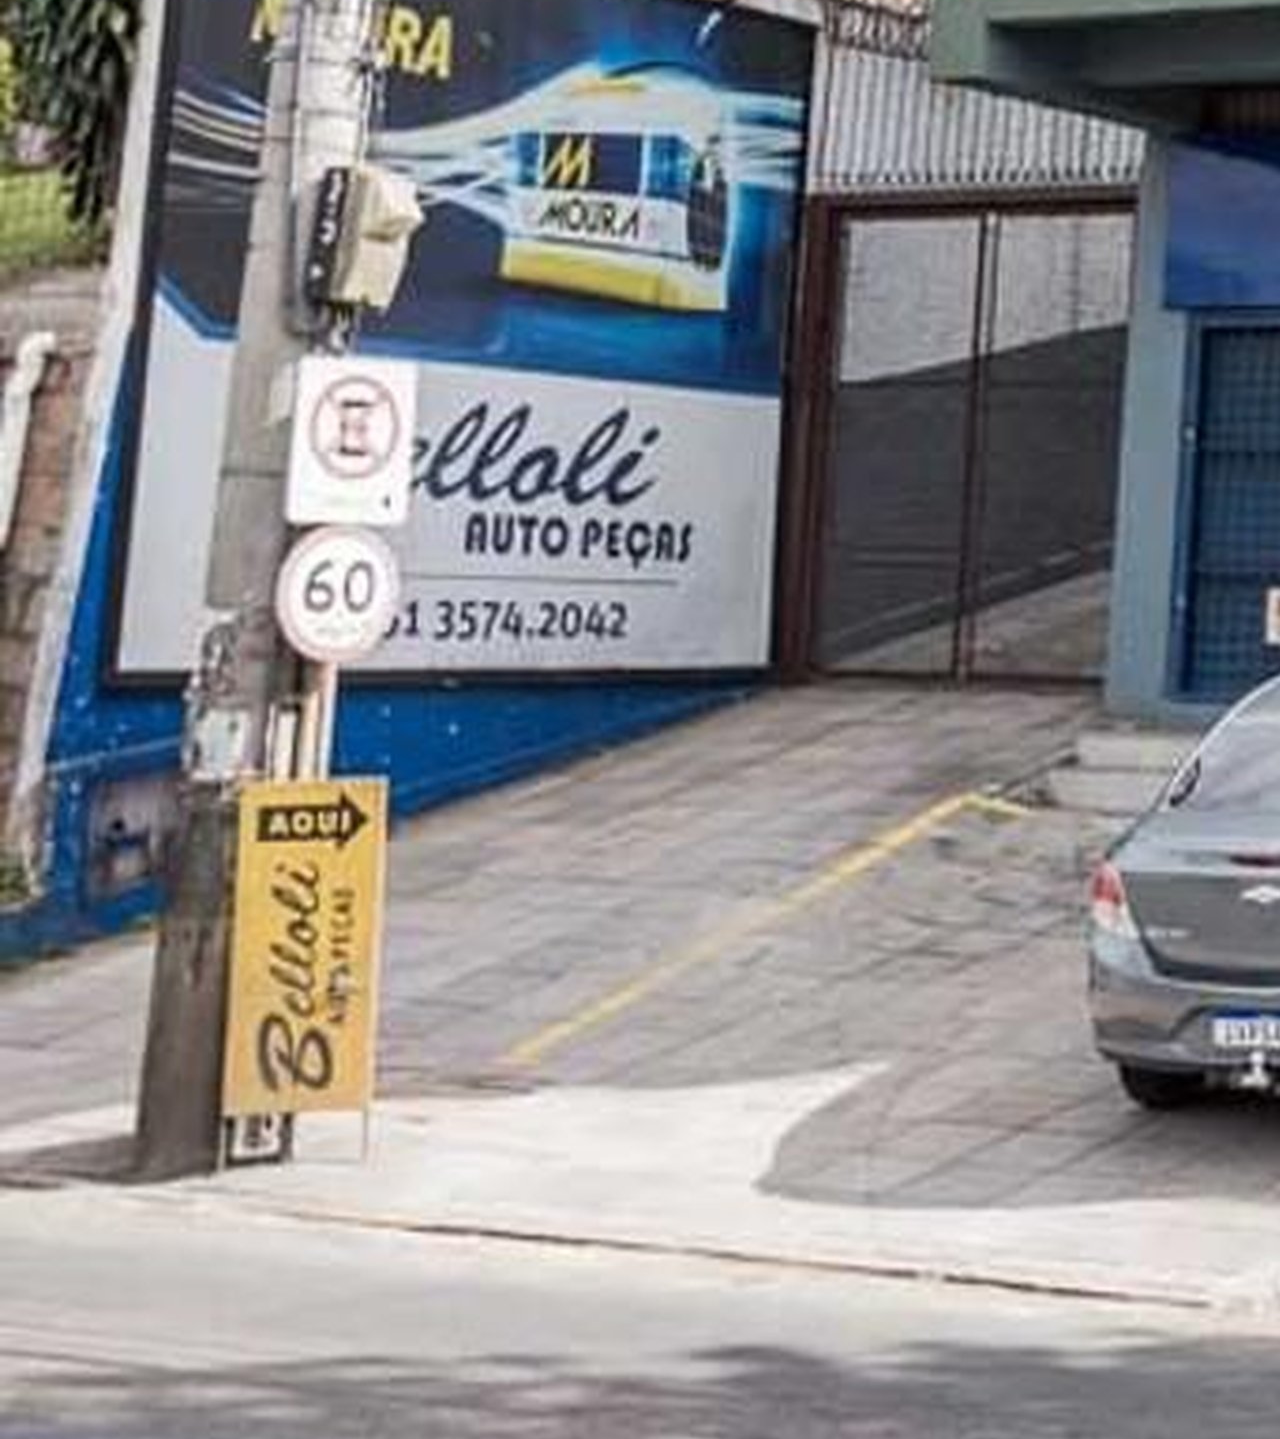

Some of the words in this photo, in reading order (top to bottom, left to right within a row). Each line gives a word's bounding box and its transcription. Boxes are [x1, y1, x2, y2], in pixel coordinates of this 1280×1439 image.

[539, 196, 641, 240] MOURA
[463, 511, 571, 559] AUTO
[578, 517, 695, 571] PEÇAS
[303, 559, 376, 614] 60
[432, 599, 629, 642] 3574.2042
[257, 857, 334, 1095] Belloli
